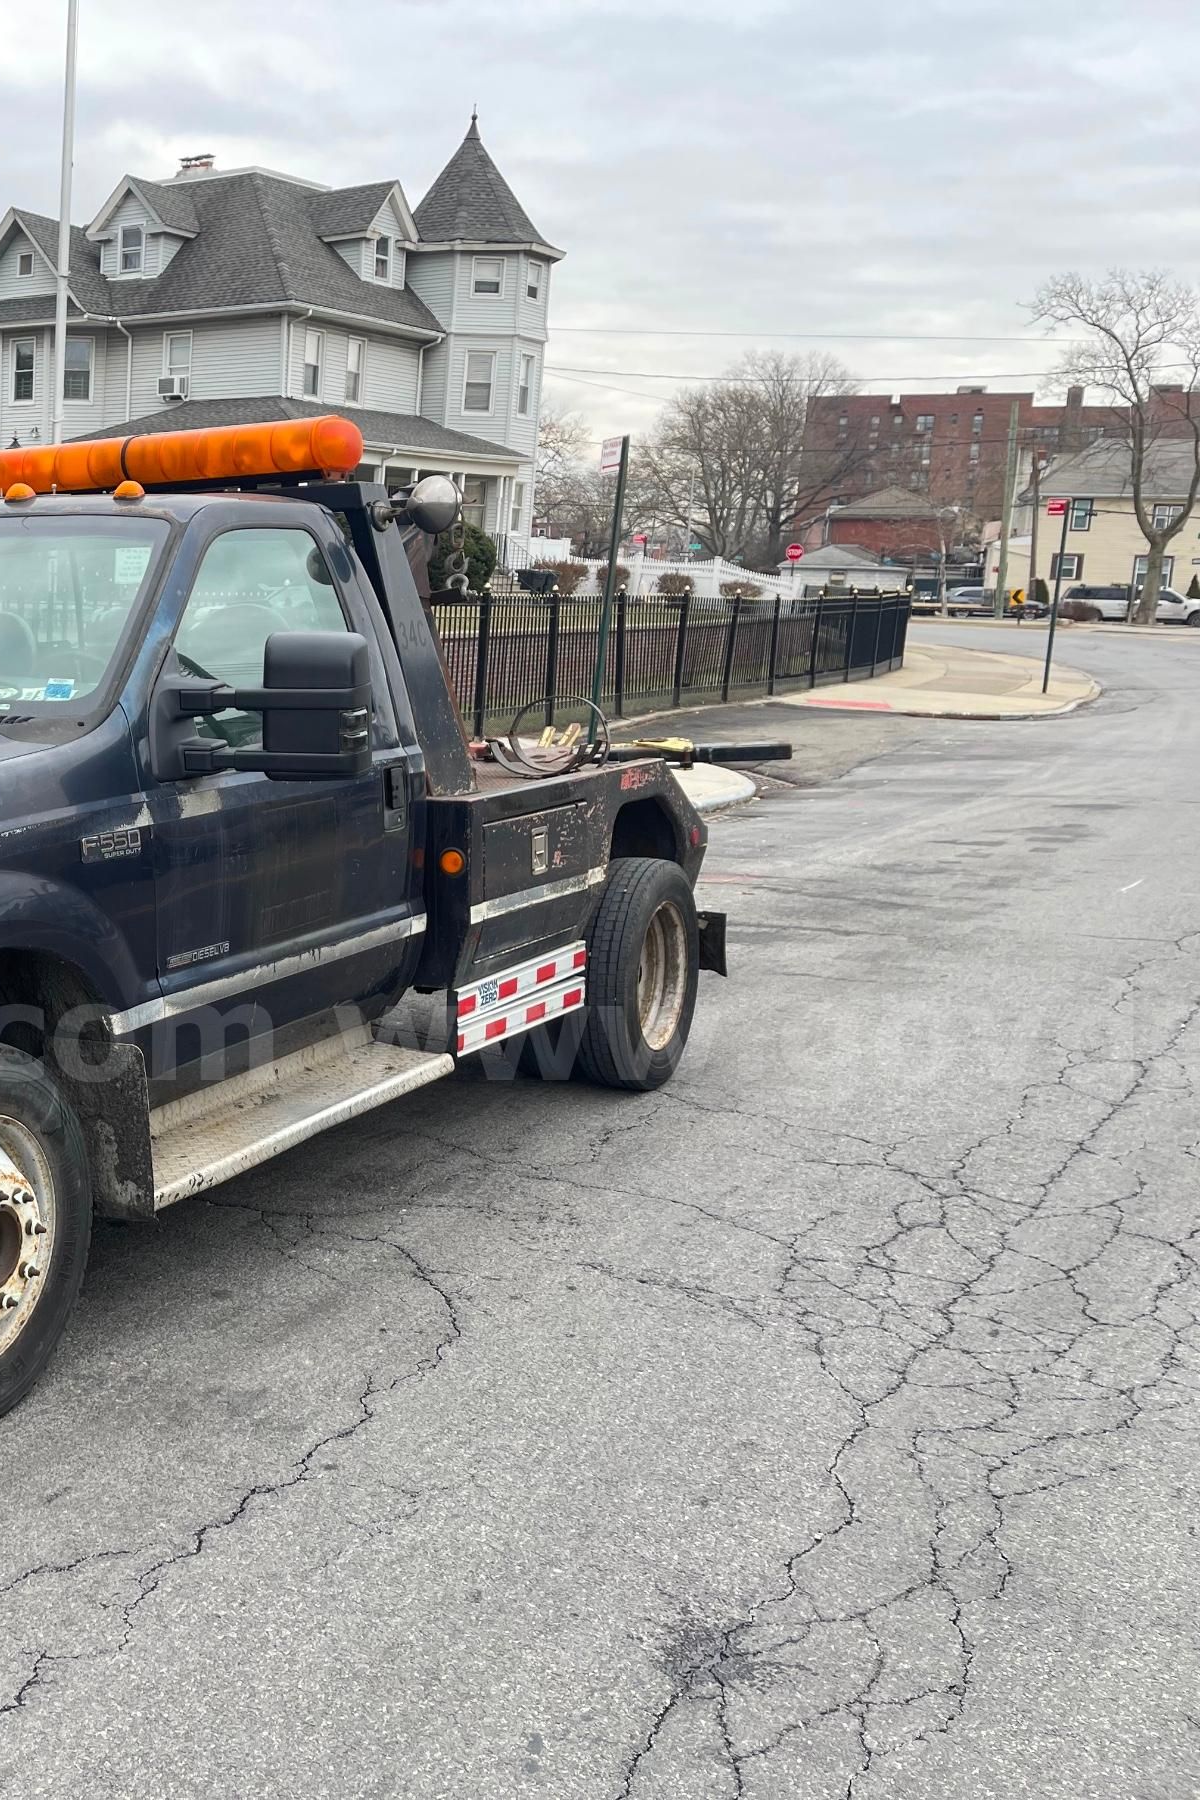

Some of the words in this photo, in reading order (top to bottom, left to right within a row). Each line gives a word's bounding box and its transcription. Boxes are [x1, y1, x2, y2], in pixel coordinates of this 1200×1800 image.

[787, 548, 803, 556] STOP
[103, 850, 125, 859] SUPER
[125, 847, 142, 856] DUTY
[192, 945, 220, 962] DIESEL
[219, 942, 231, 954] V8
[477, 978, 499, 996] VISION
[480, 990, 498, 1007] ZERO
